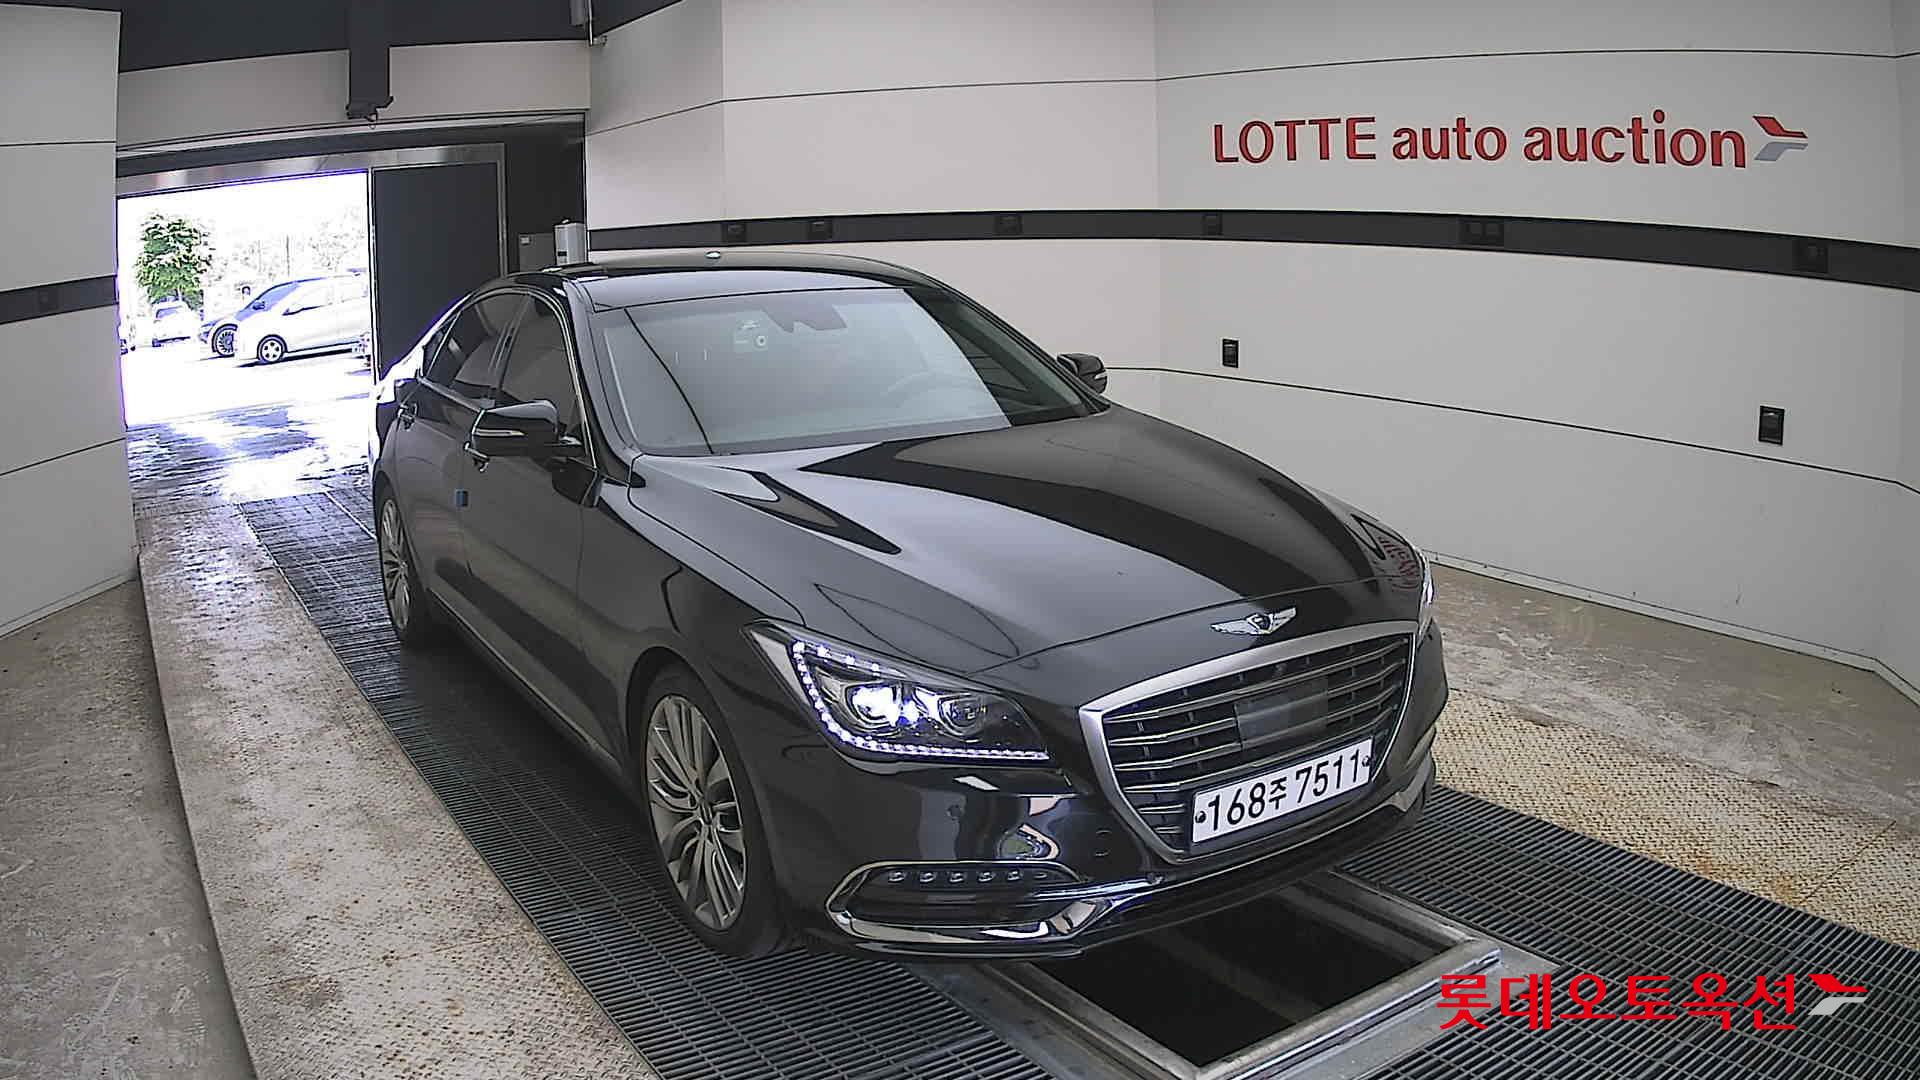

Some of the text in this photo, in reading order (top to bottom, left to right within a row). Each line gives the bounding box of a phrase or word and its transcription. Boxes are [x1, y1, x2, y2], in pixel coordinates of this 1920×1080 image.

[1212, 109, 1746, 168] LOTTE auto auction
[1207, 749, 1360, 832] 168주 7511
